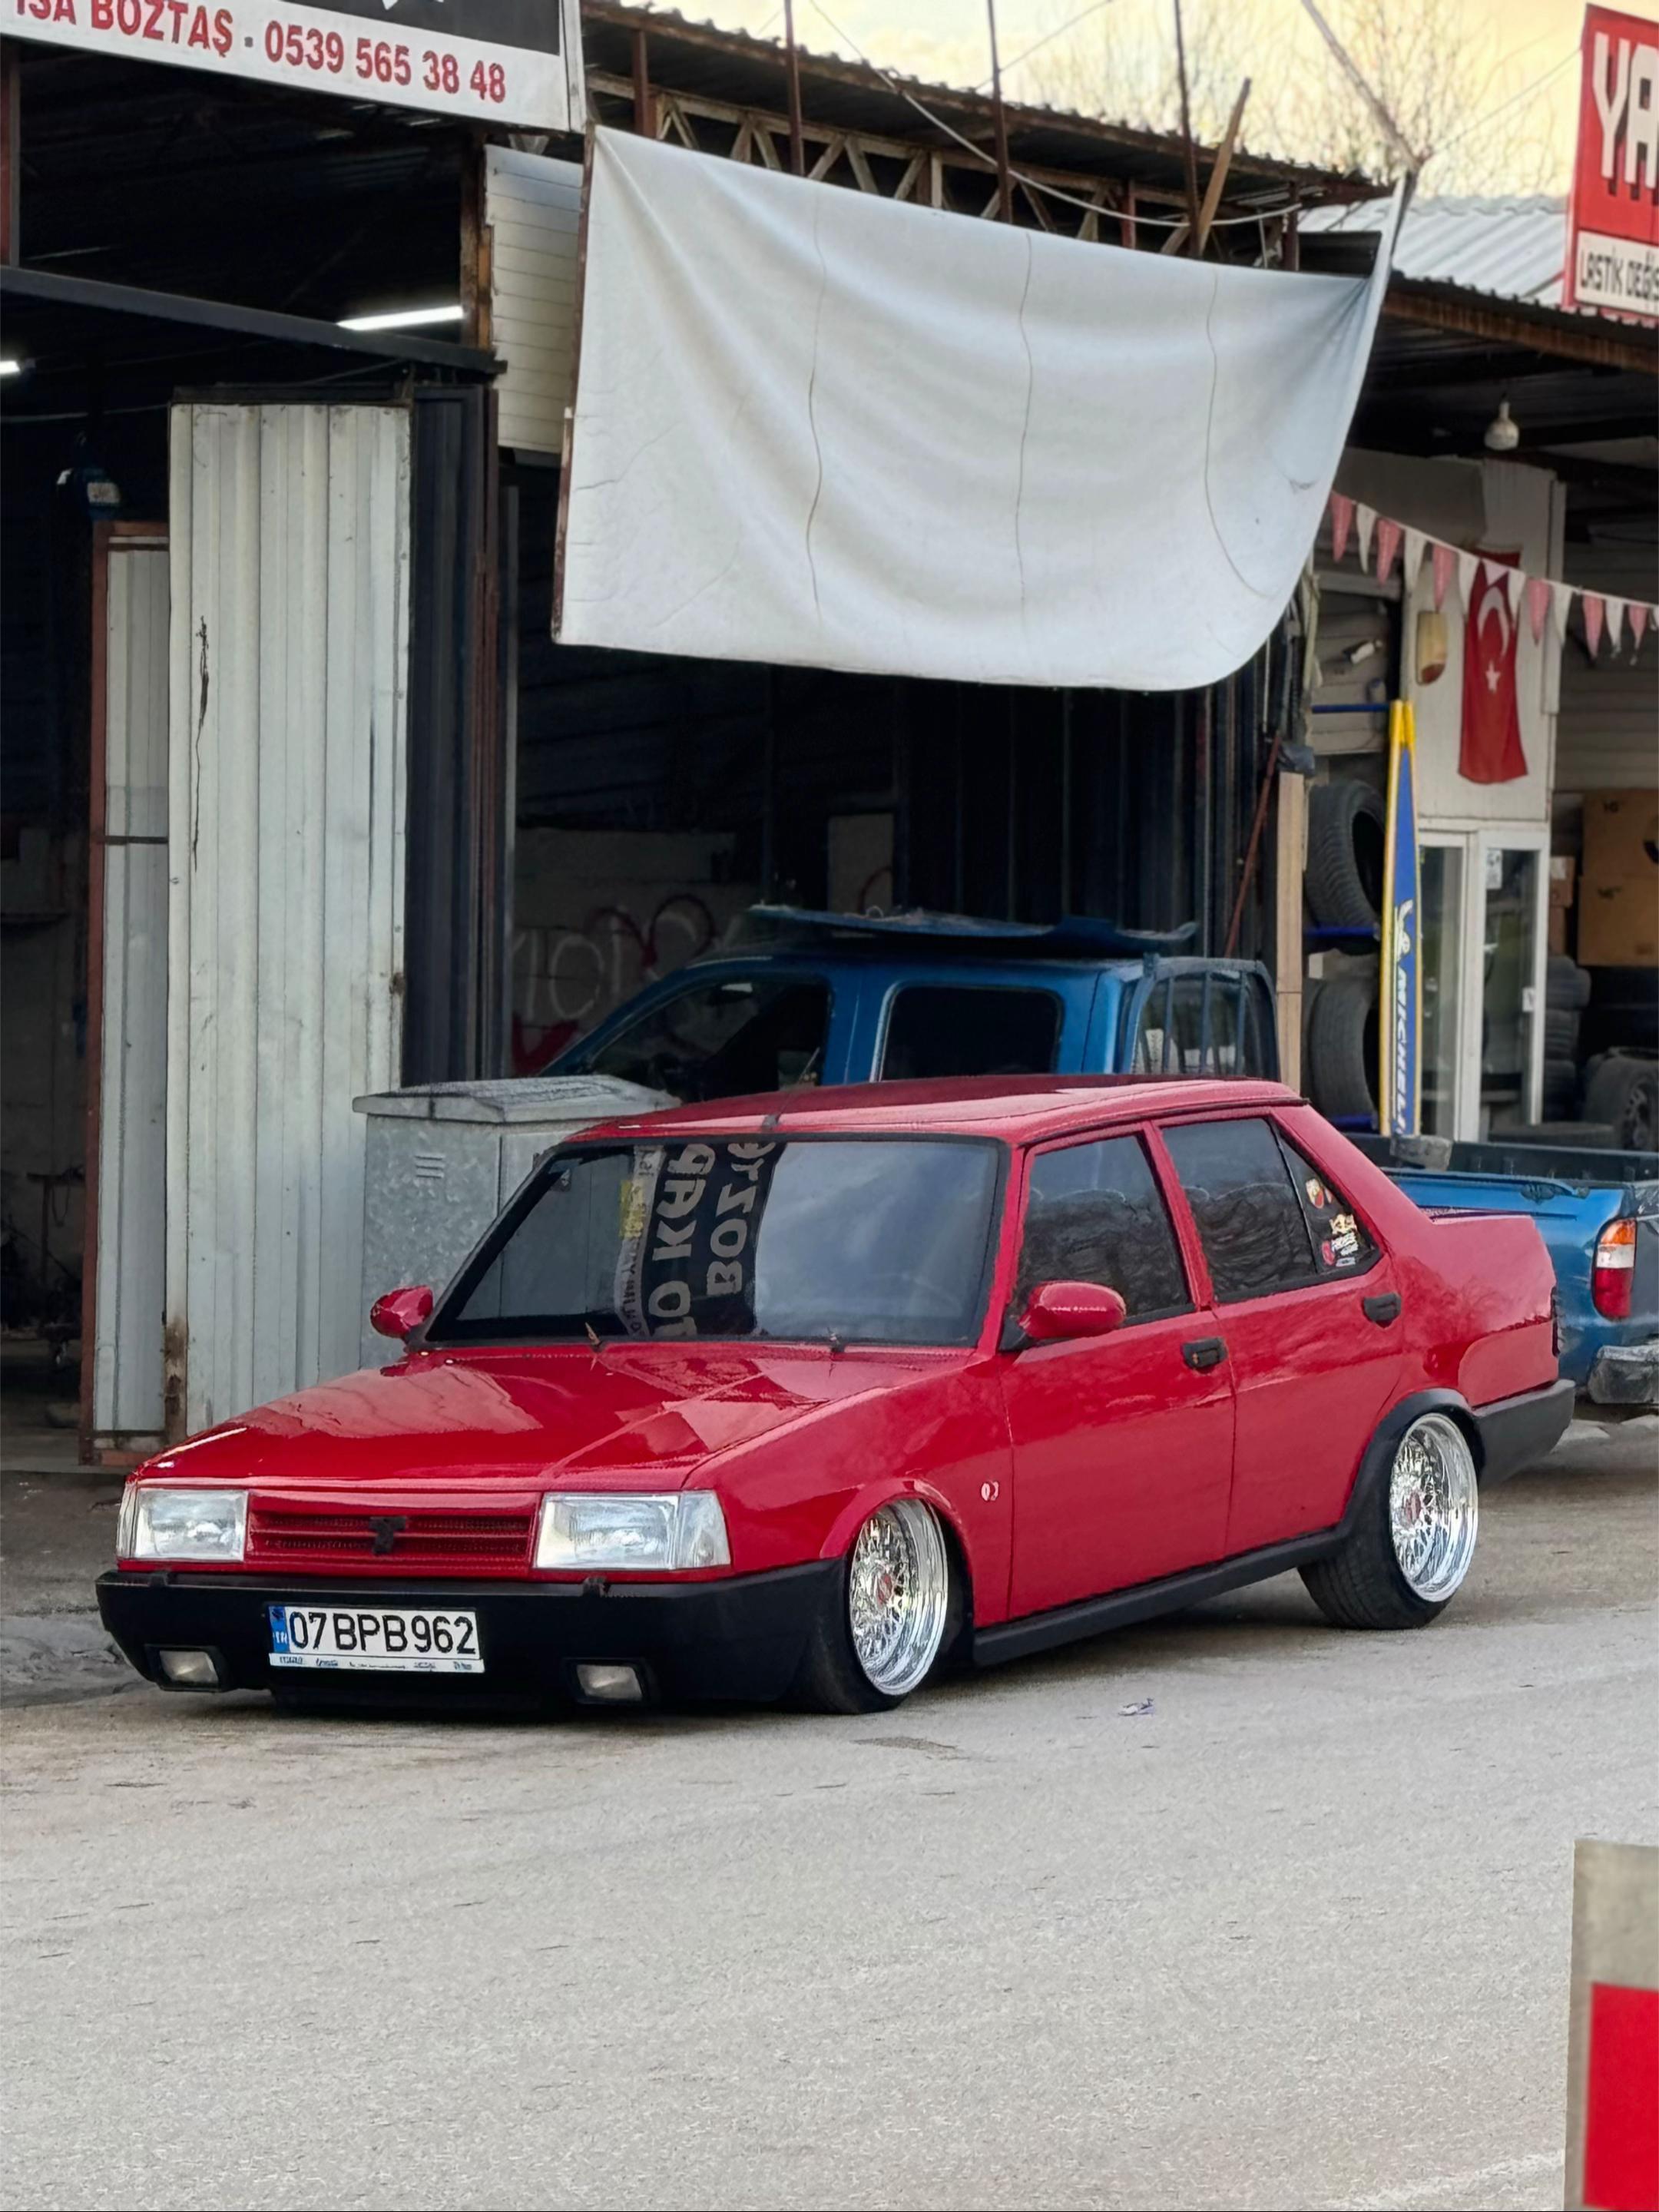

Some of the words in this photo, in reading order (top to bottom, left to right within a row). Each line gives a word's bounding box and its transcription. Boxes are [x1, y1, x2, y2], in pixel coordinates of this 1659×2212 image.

[91, 0, 233, 58] BOZTAŞ
[265, 20, 344, 74] 0539
[356, 37, 412, 85] 565
[422, 50, 460, 94] 38
[470, 60, 506, 103] 48
